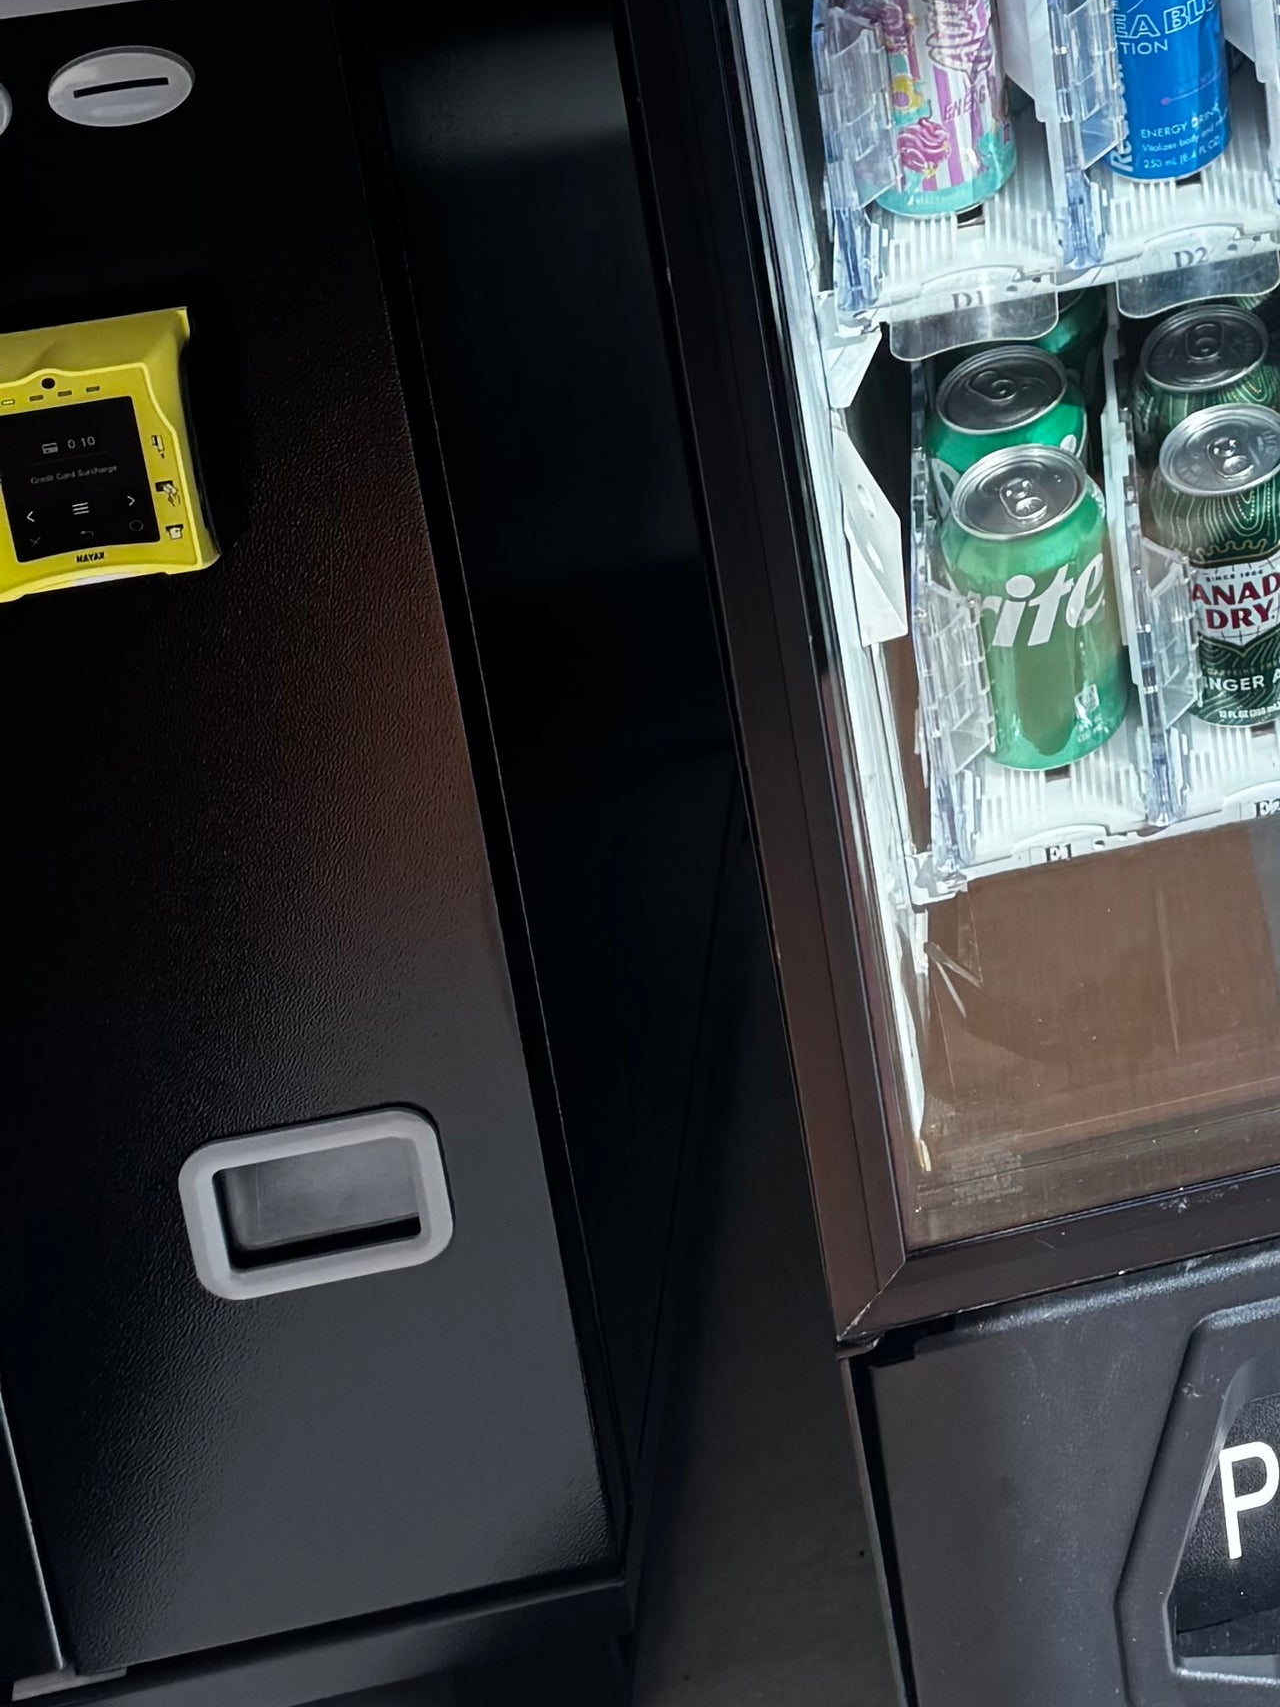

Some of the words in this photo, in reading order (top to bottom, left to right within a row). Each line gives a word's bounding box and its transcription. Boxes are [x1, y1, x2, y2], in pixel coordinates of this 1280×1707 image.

[1141, 122, 1187, 138] ENERGY
[1172, 247, 1210, 270] D2
[951, 289, 985, 311] D1
[67, 436, 96, 450] 0.10
[76, 551, 105, 564] NAYAX
[980, 552, 1104, 647] rite
[1044, 842, 1073, 863] E1
